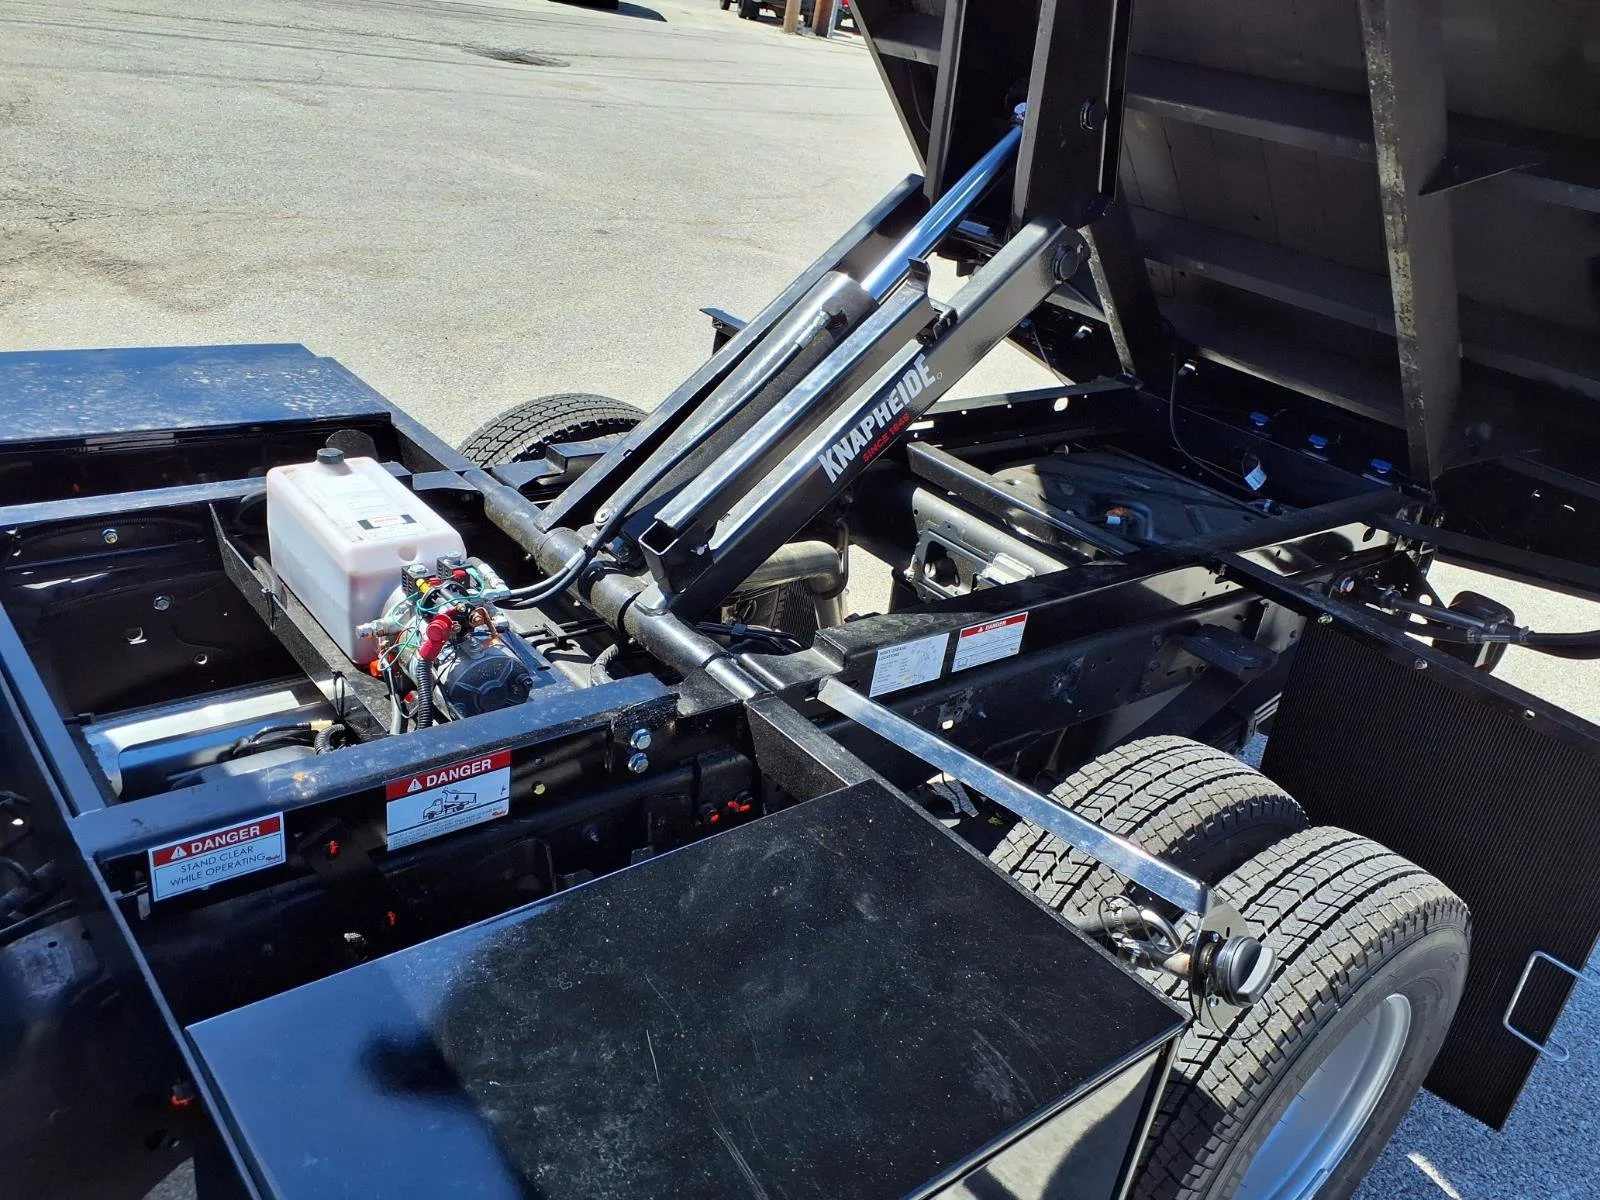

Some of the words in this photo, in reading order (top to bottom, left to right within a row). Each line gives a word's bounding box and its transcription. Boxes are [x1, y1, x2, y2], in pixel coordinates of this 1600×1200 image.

[818, 353, 936, 483] KNAPHEIDE
[863, 432, 890, 462] SINCE
[984, 620, 1007, 631] DANGER
[426, 759, 492, 787] DANGER
[191, 825, 260, 854] DANGER
[170, 872, 201, 887] WHILE
[205, 852, 266, 876] OPERATING
[181, 856, 217, 873] STAND
[219, 845, 254, 861] CLEAR
